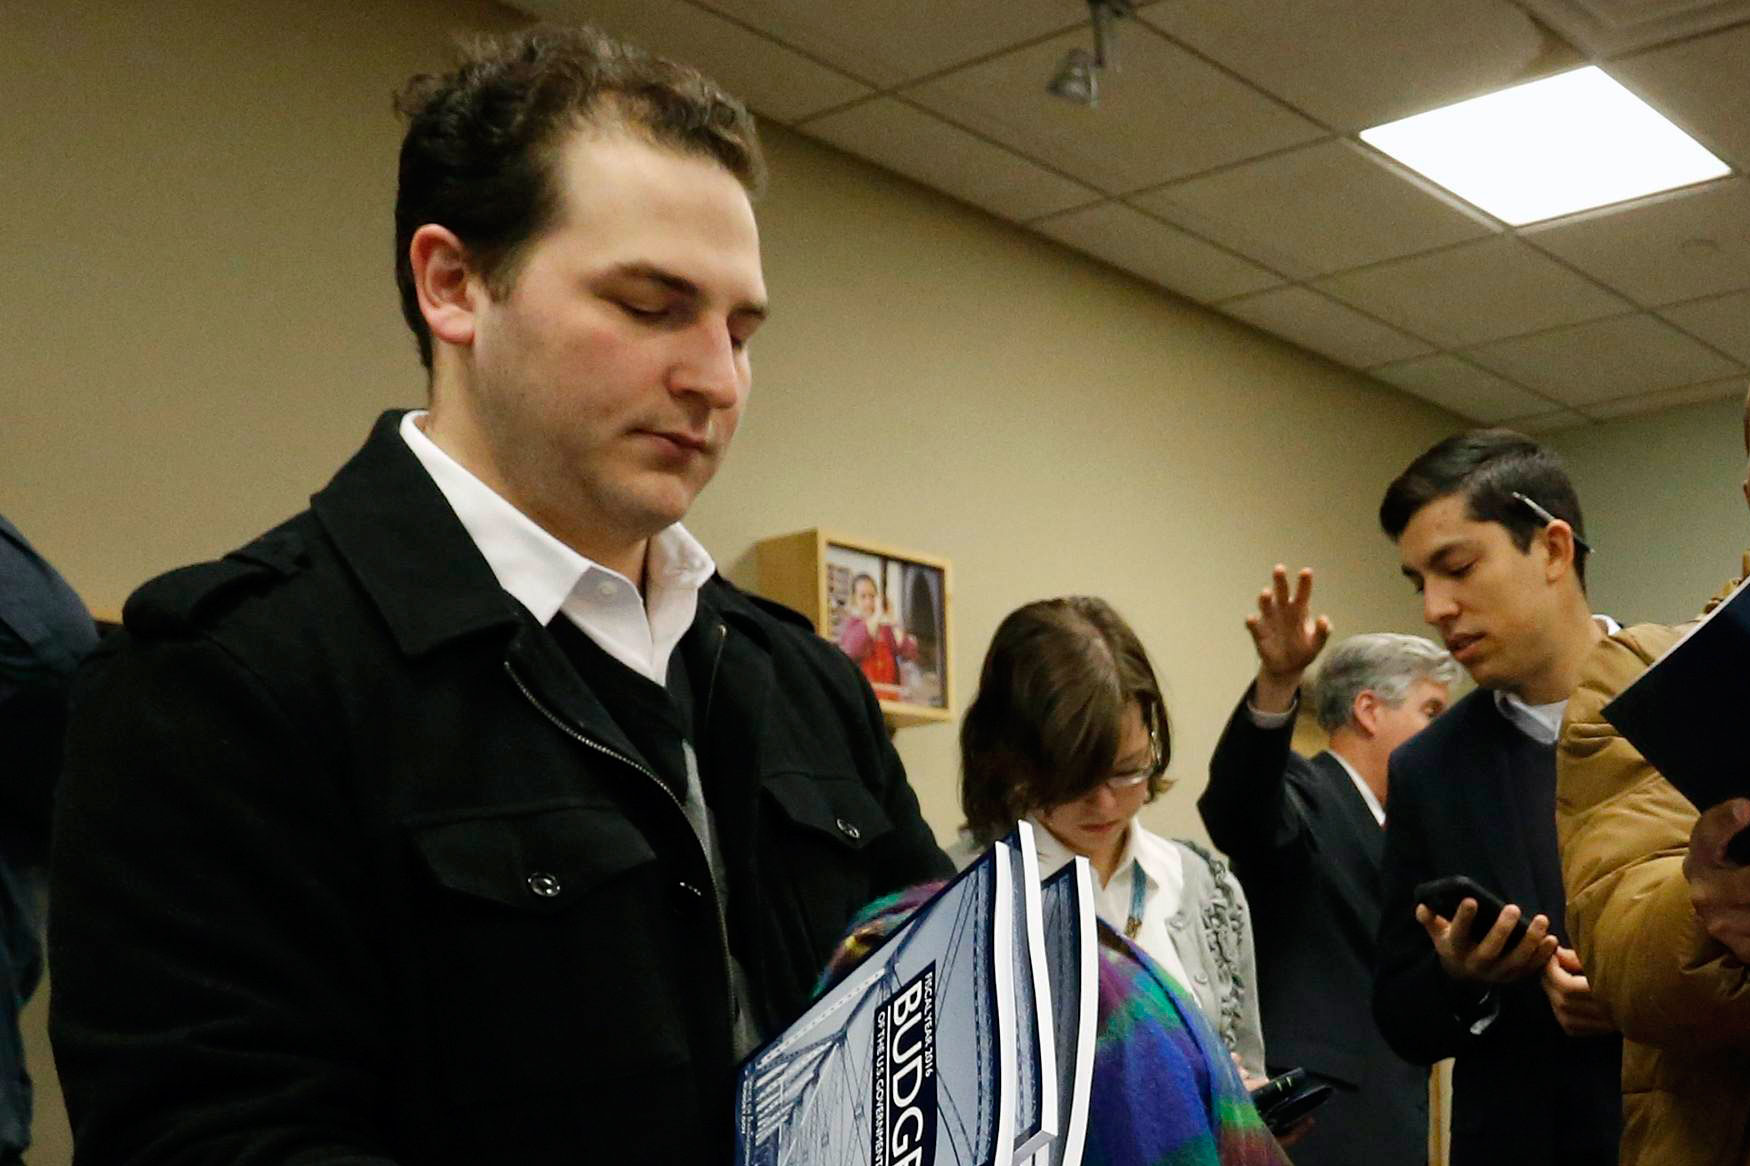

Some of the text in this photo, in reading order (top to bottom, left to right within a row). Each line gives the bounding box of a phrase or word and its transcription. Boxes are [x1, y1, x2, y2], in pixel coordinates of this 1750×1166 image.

[877, 1028, 885, 1056] THE
[878, 1011, 886, 1029] OF
[924, 971, 934, 1077] FISCAL YEAR 2016
[875, 1079, 884, 1166] GOVERNMENT
